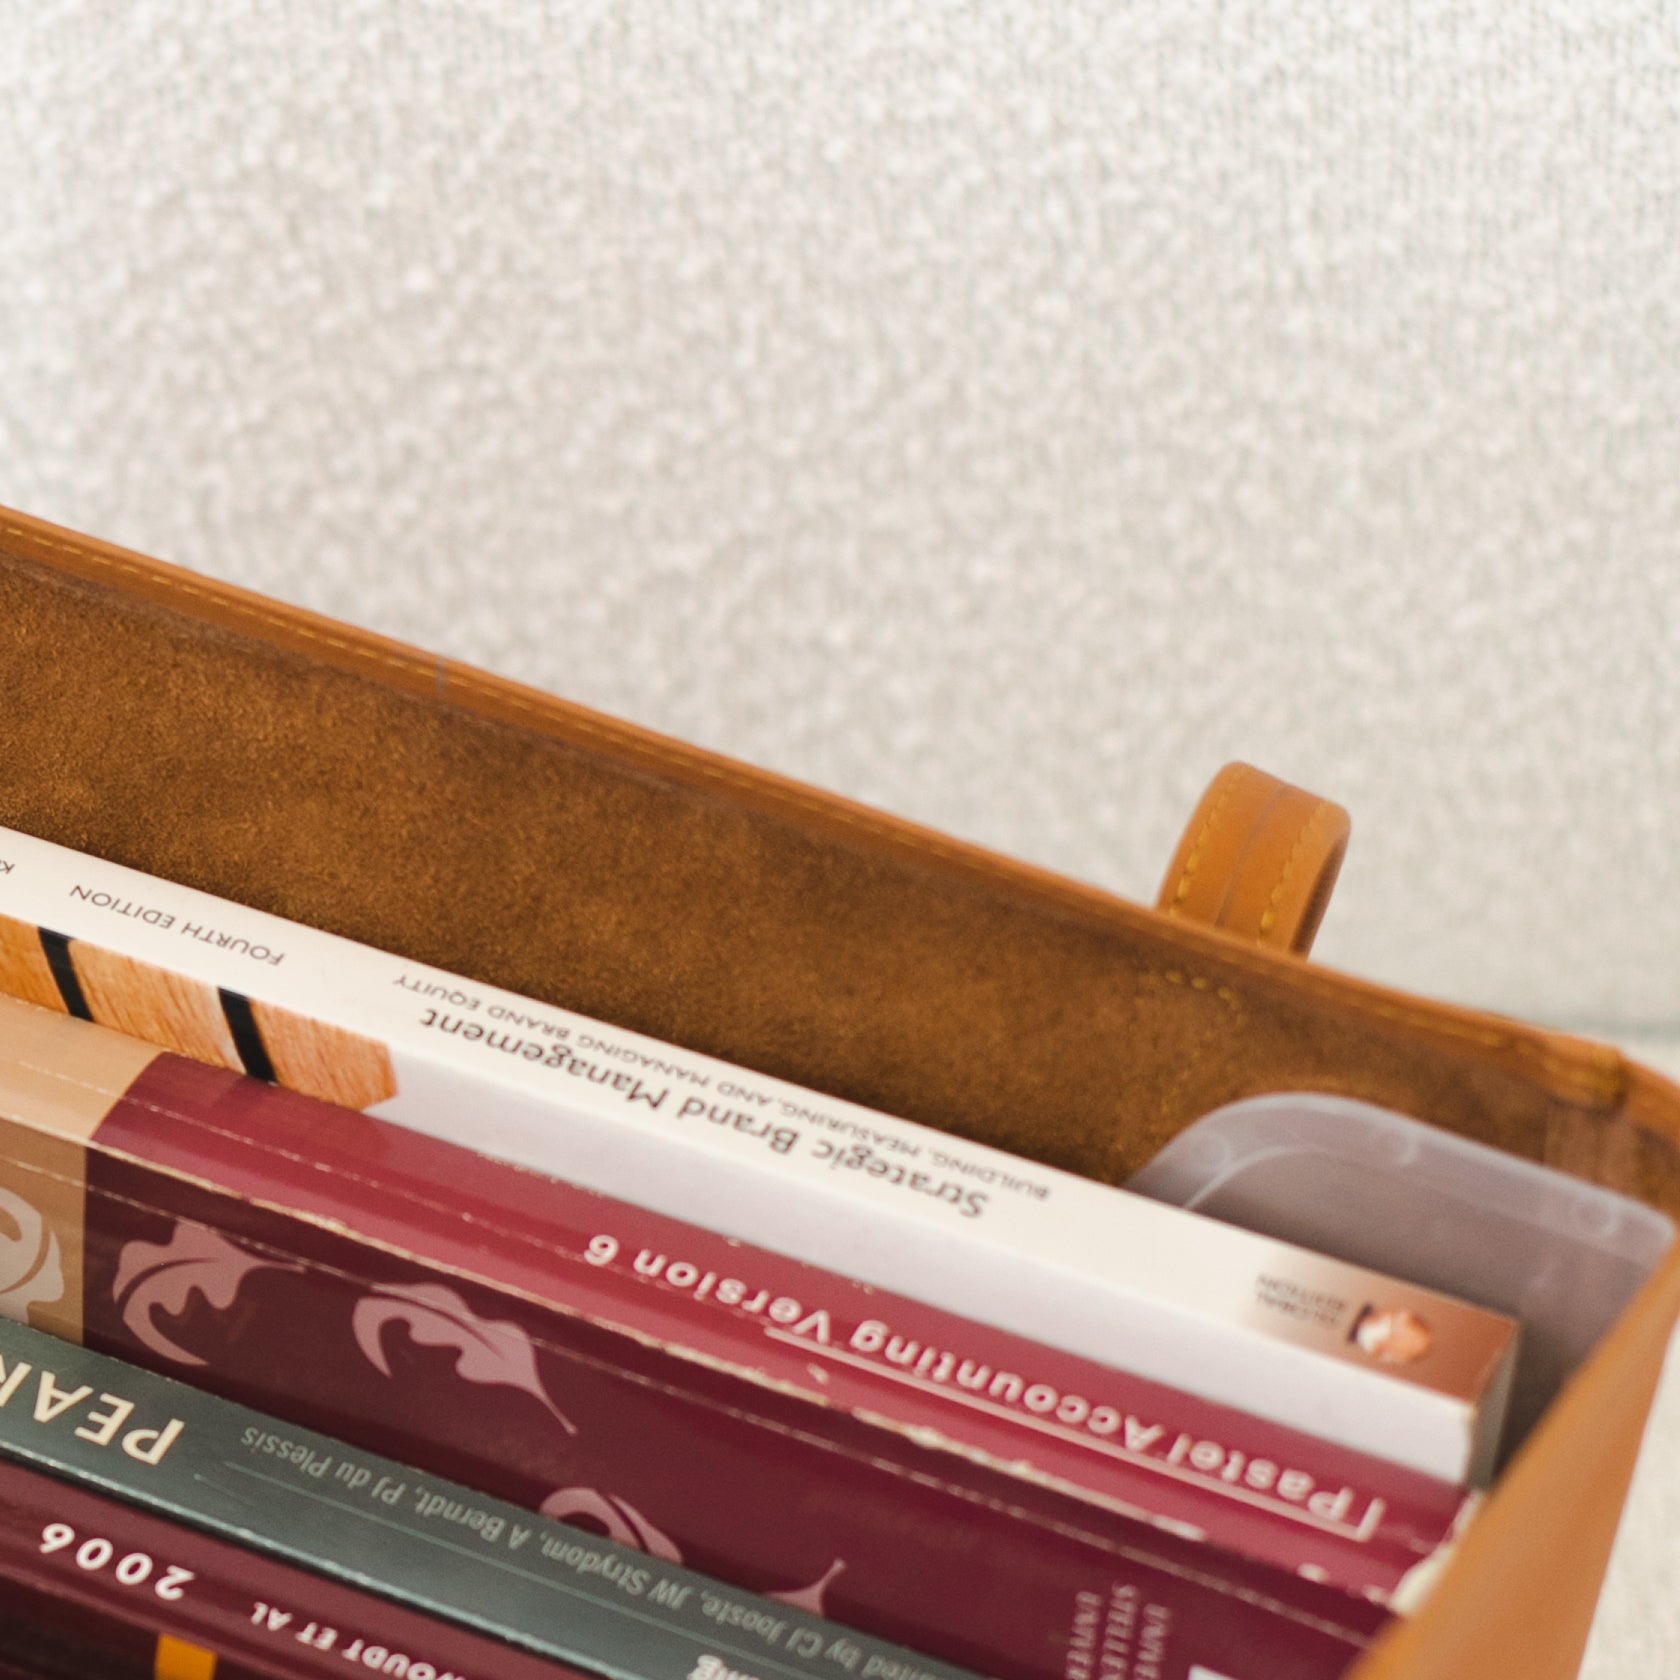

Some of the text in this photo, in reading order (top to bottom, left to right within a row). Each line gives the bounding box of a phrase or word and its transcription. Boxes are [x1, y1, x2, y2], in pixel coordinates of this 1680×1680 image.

[69, 883, 287, 966] FOURTH EDITION
[392, 972, 484, 1014] EQUITY
[487, 1004, 573, 1043] BRAND
[576, 1033, 712, 1090] MANAGING
[417, 1006, 990, 1219] Strategic Brand Management
[716, 1078, 771, 1112] AND
[583, 1232, 1353, 1526] Pastel Accounting Version 6
[239, 1425, 333, 1480] Plessis
[334, 1460, 374, 1489] du
[369, 1476, 404, 1506] PJ
[414, 1486, 505, 1544] Berndt,
[506, 1525, 533, 1553] A
[38, 1522, 196, 1601] 2006
[539, 1530, 652, 1596] Strydom,
[650, 1577, 694, 1610] JW
[249, 1600, 293, 1632] AL
[700, 1588, 782, 1642] Jooste,
[295, 1619, 339, 1652] ET
[782, 1622, 822, 1660] CJ
[824, 1637, 860, 1673] by
